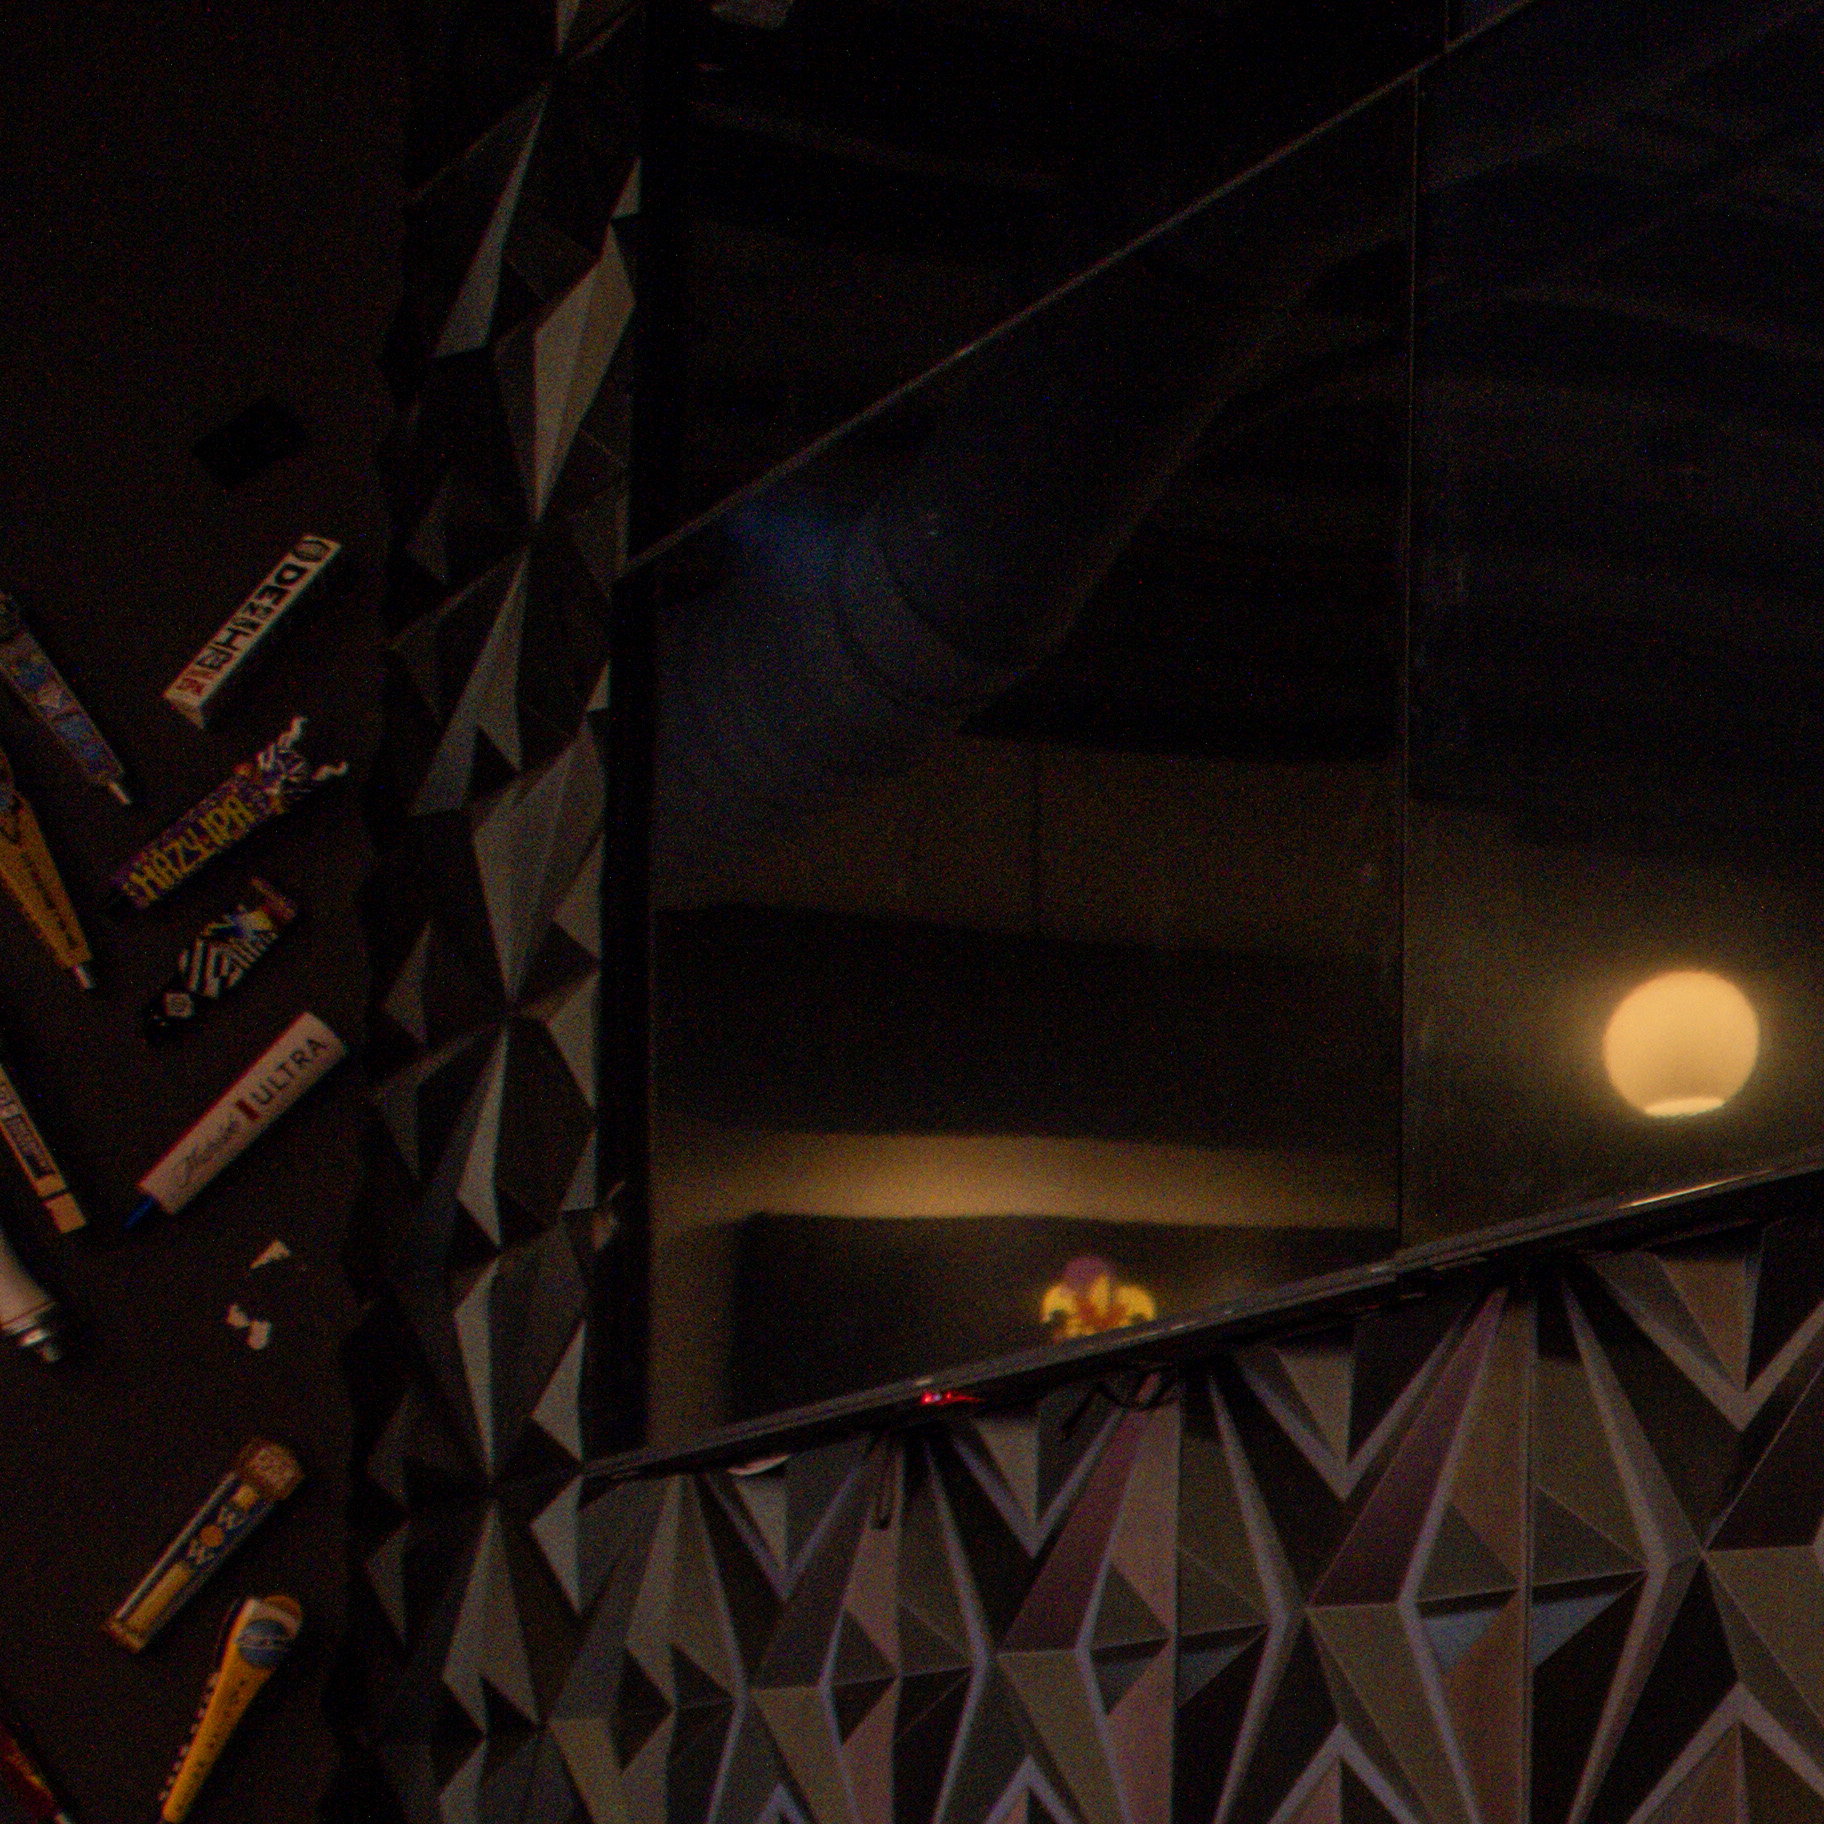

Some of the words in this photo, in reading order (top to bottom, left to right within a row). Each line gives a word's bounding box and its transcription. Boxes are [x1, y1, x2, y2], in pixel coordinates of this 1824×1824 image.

[130, 829, 212, 900] HAZY
[198, 792, 259, 850] IPA
[252, 1037, 328, 1106] ULTRA
